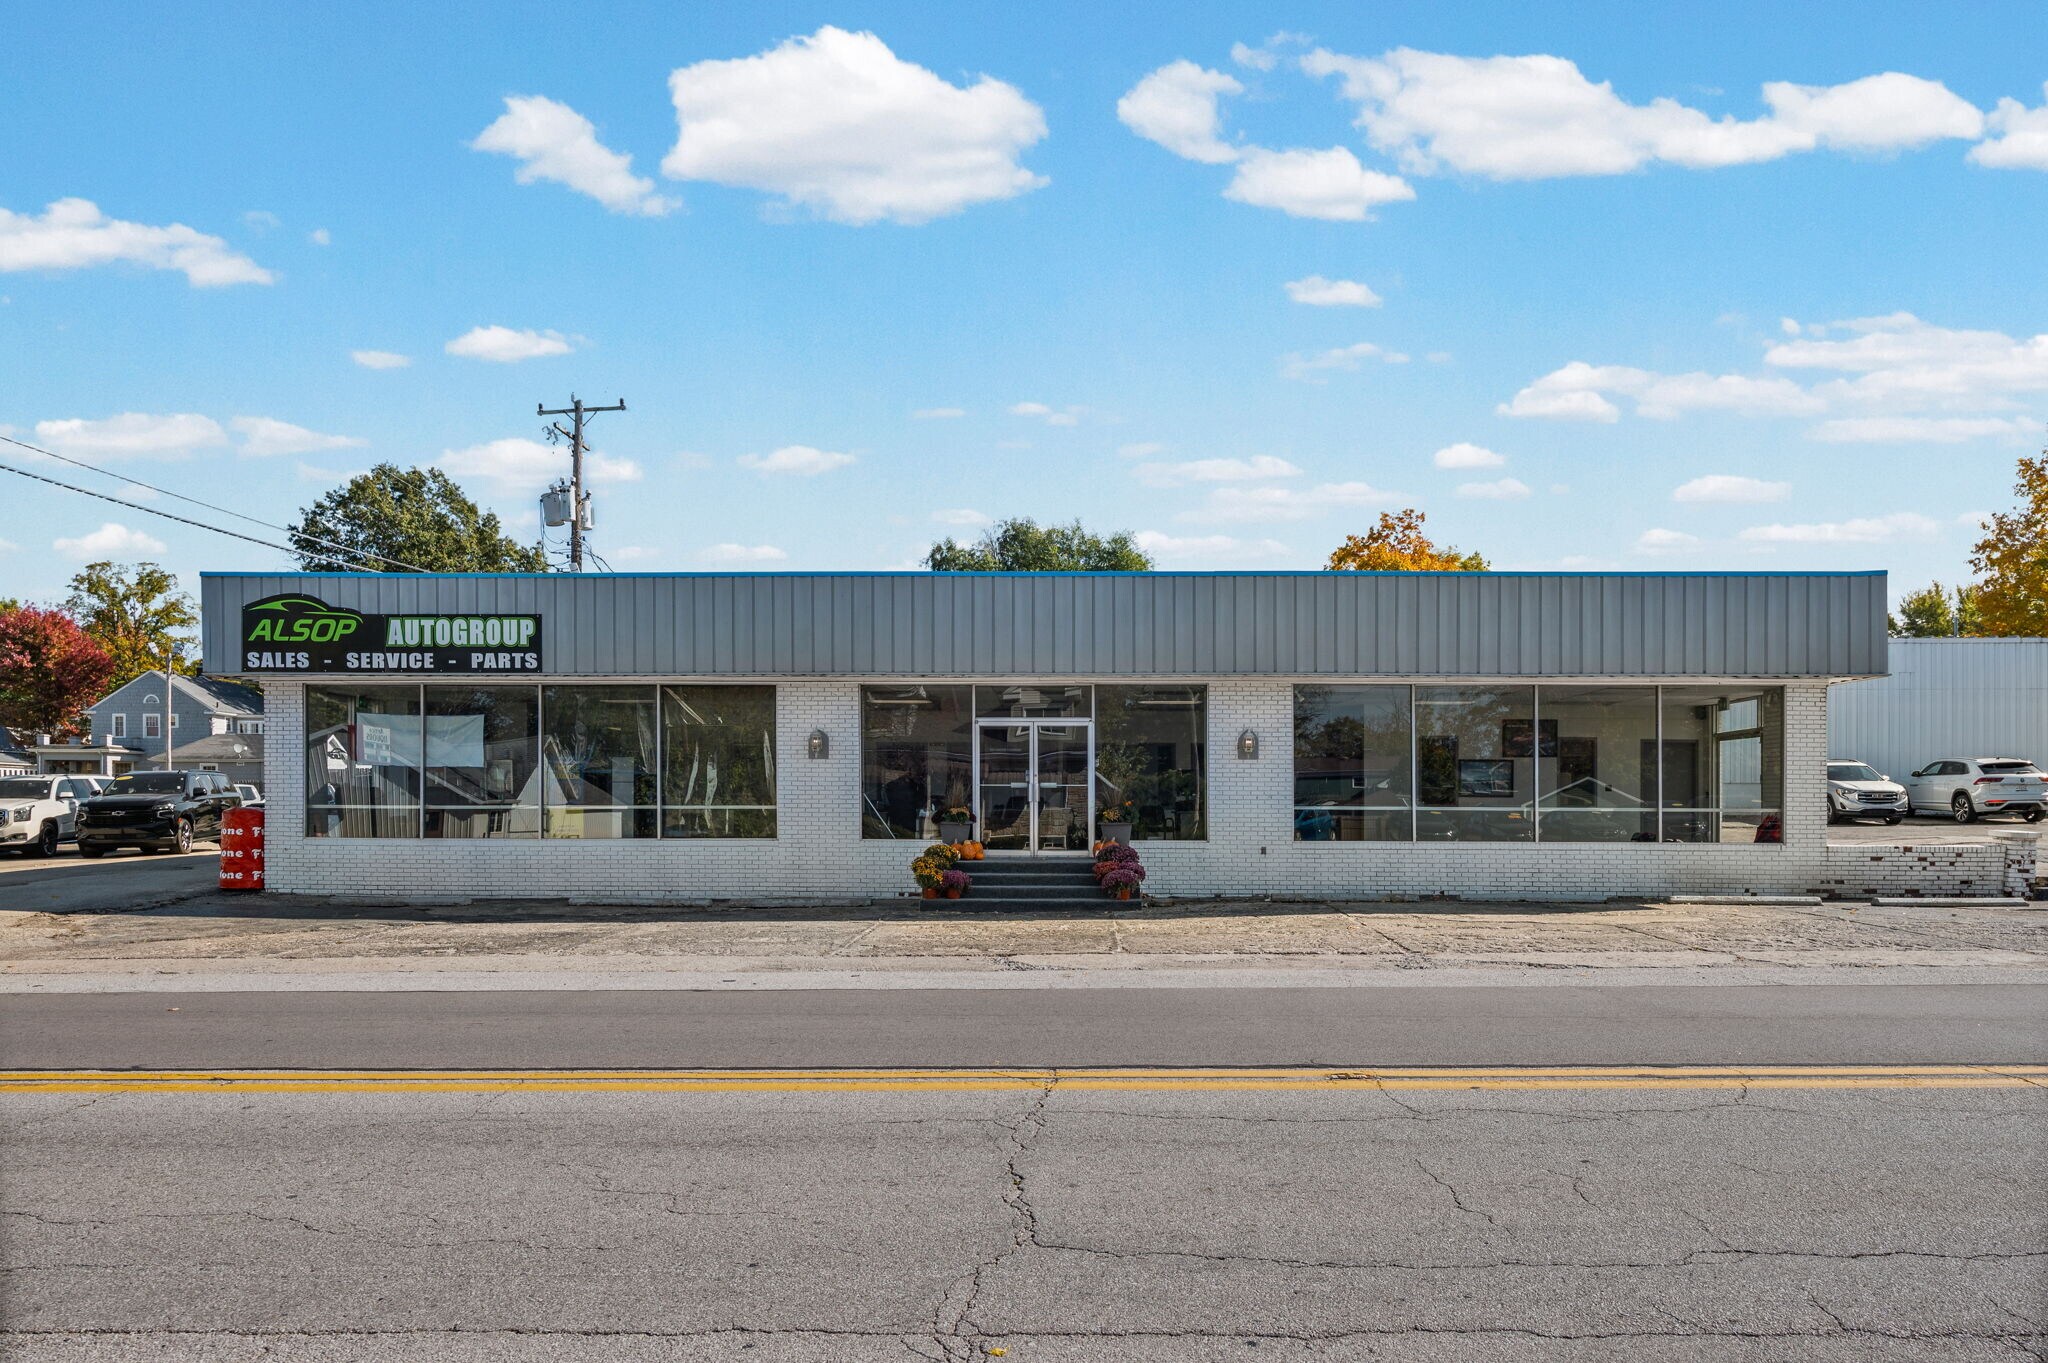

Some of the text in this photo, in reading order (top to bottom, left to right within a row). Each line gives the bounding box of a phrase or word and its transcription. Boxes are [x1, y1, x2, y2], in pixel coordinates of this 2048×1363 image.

[248, 617, 536, 648] ALSOP AUTOGROUP
[247, 651, 310, 669] SALES
[346, 652, 434, 669] SERVICE
[471, 652, 538, 669] PARTS
